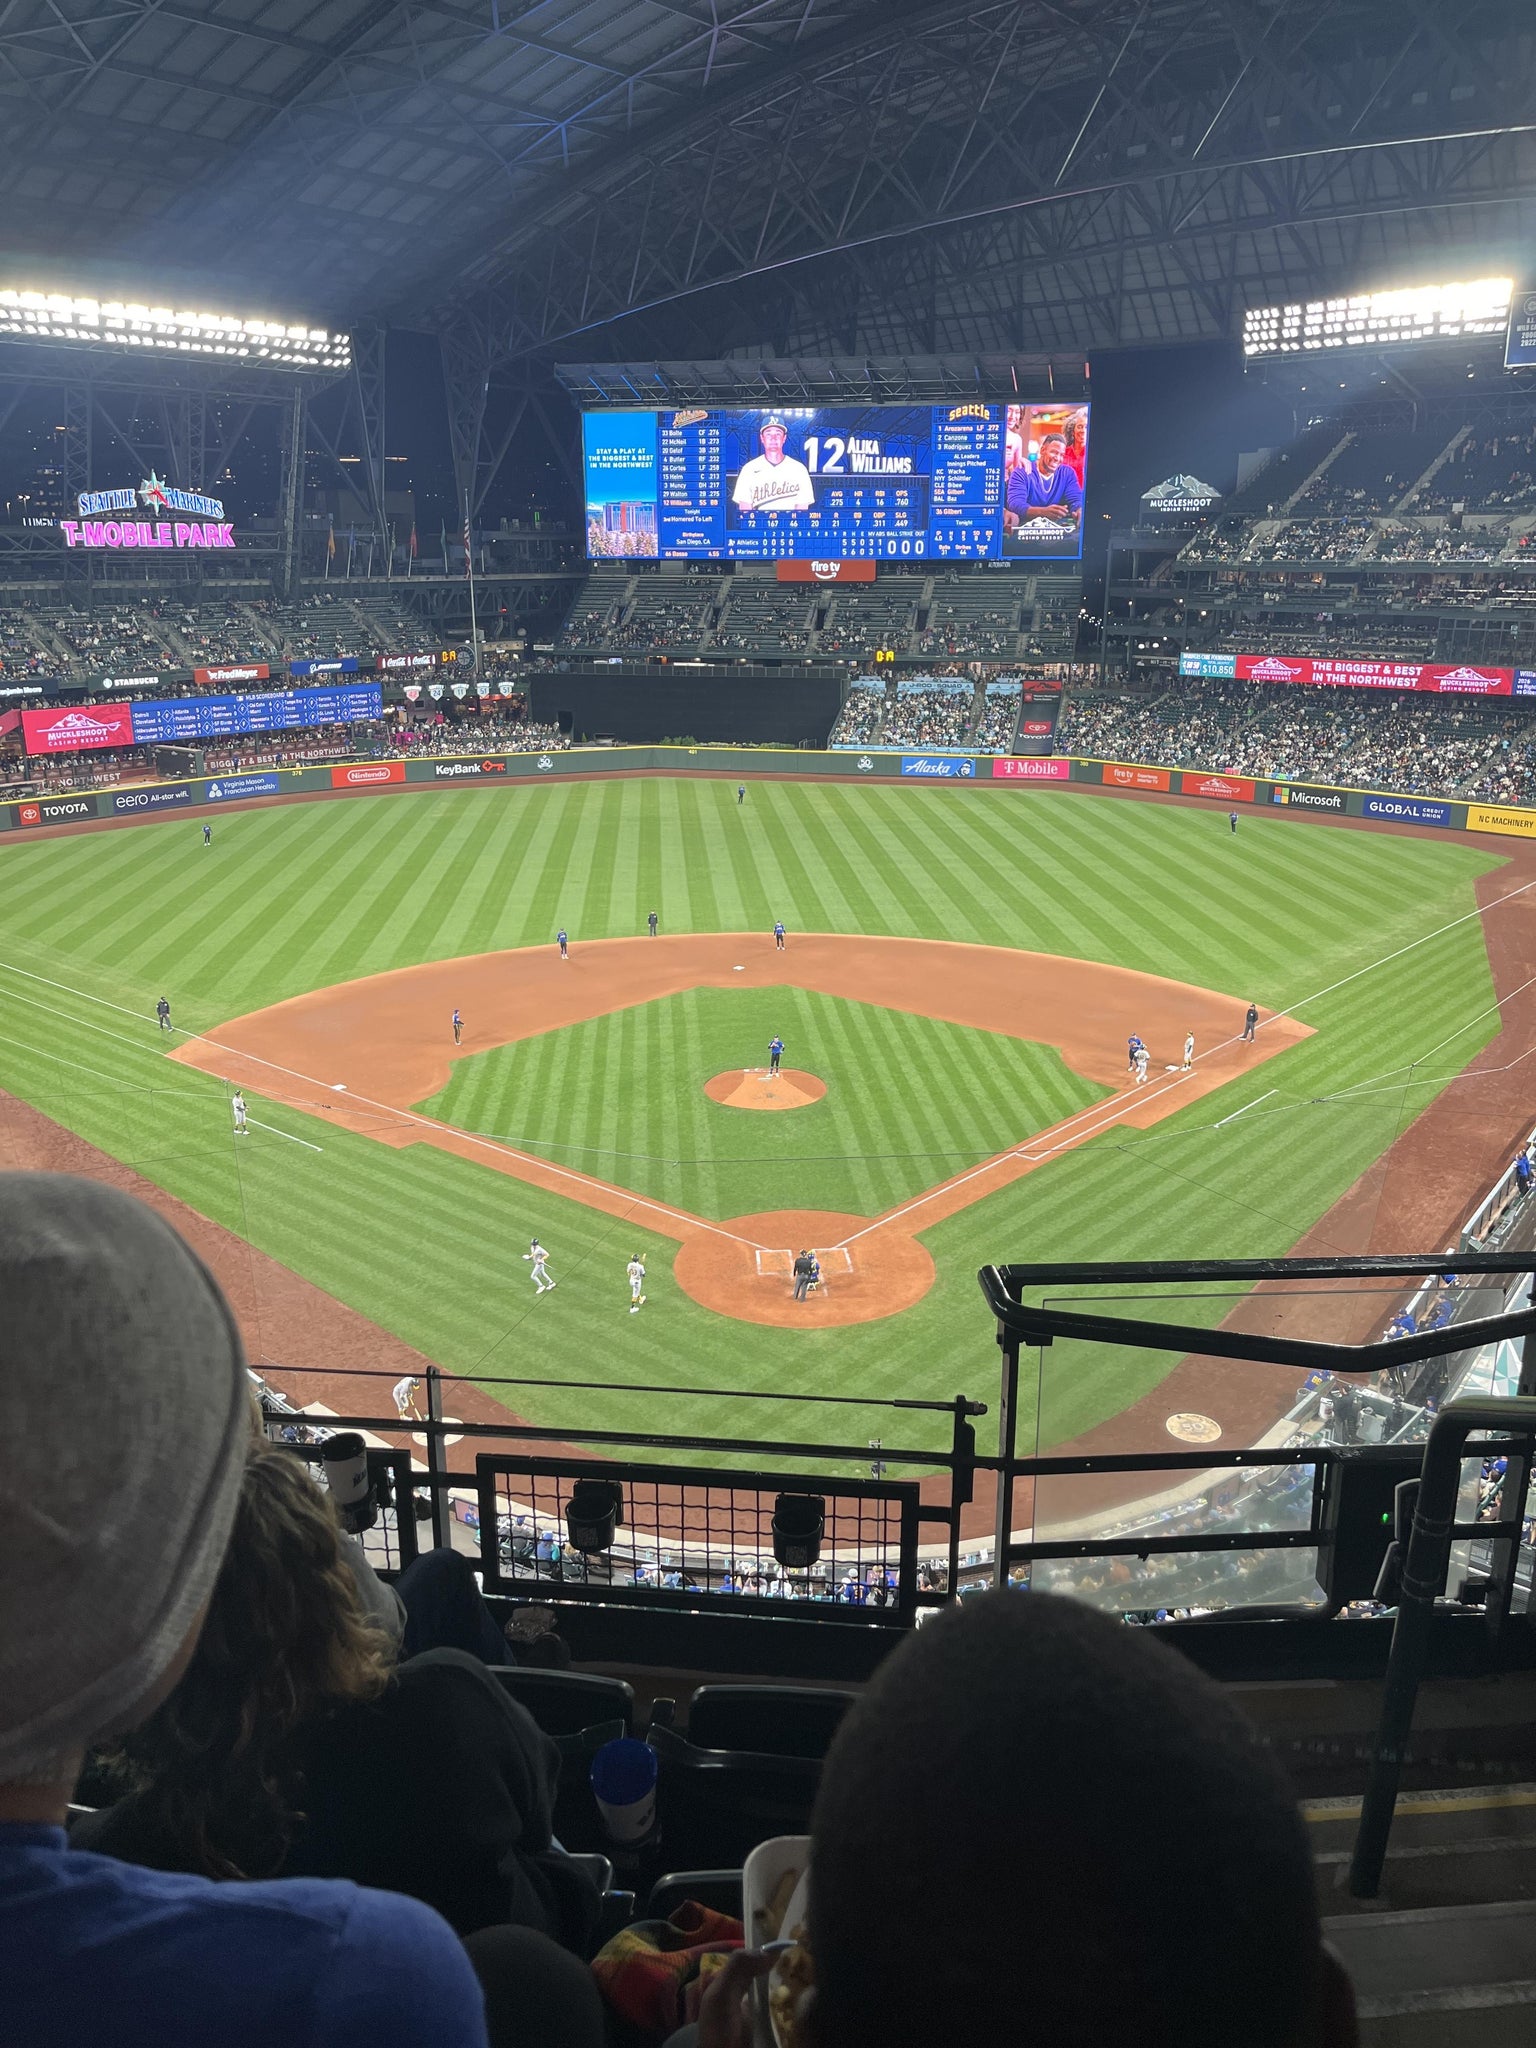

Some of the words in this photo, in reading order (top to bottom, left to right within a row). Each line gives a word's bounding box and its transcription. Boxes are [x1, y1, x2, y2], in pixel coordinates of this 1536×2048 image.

[949, 403, 990, 421] seattle
[804, 437, 845, 473] 12
[847, 436, 880, 455] ALIKA
[851, 454, 912, 474] WILLIAMS
[752, 481, 800, 502] Athletics
[78, 487, 138, 517] SEATTLE
[167, 487, 225, 520] MARINERS
[1150, 498, 1212, 507] MUCKLESHOOT
[60, 520, 174, 548] T-MOBILE
[174, 522, 237, 548] PARK
[887, 540, 897, 554] 0
[901, 540, 910, 554] 0
[915, 540, 924, 554] 0
[811, 561, 828, 572] fire
[828, 562, 841, 572] tv
[1202, 664, 1234, 675] $10,850
[1312, 661, 1332, 671] THE
[1334, 662, 1381, 674] BIGGEST
[1383, 665, 1391, 674] &
[1393, 666, 1423, 676] BEST
[114, 676, 159, 687] STARBUCKS
[1312, 672, 1324, 682] IN
[1326, 673, 1346, 683] THE
[1349, 674, 1419, 687] NORTHWEST
[1439, 680, 1489, 689] MUCKLESHOOT
[47, 728, 108, 740] MUCKLESHOOT
[48, 739, 78, 747] CASINO
[80, 736, 109, 744] RESORT
[257, 755, 276, 764] BEST
[289, 751, 305, 760] THE
[539, 758, 550, 766] 50
[861, 758, 871, 767] 50
[435, 763, 481, 776] KeyBank
[905, 760, 951, 774] Alaska
[1004, 761, 1015, 774] T
[1017, 761, 1058, 775] Mobile
[1114, 769, 1126, 778] fire
[350, 770, 388, 780] Nintendo
[222, 779, 247, 789] Virginia
[248, 777, 265, 786] Mason
[224, 785, 254, 797] Franciscan
[255, 783, 275, 792] Health
[116, 793, 149, 808] eero
[150, 792, 170, 803] All-star
[1291, 791, 1341, 808] Microsoft
[43, 802, 89, 817] TOYOTA
[1369, 801, 1420, 817] GLOBAL
[1422, 807, 1444, 815] CREDIT
[1478, 815, 1490, 824] NC
[1491, 816, 1534, 828] MACHINERY
